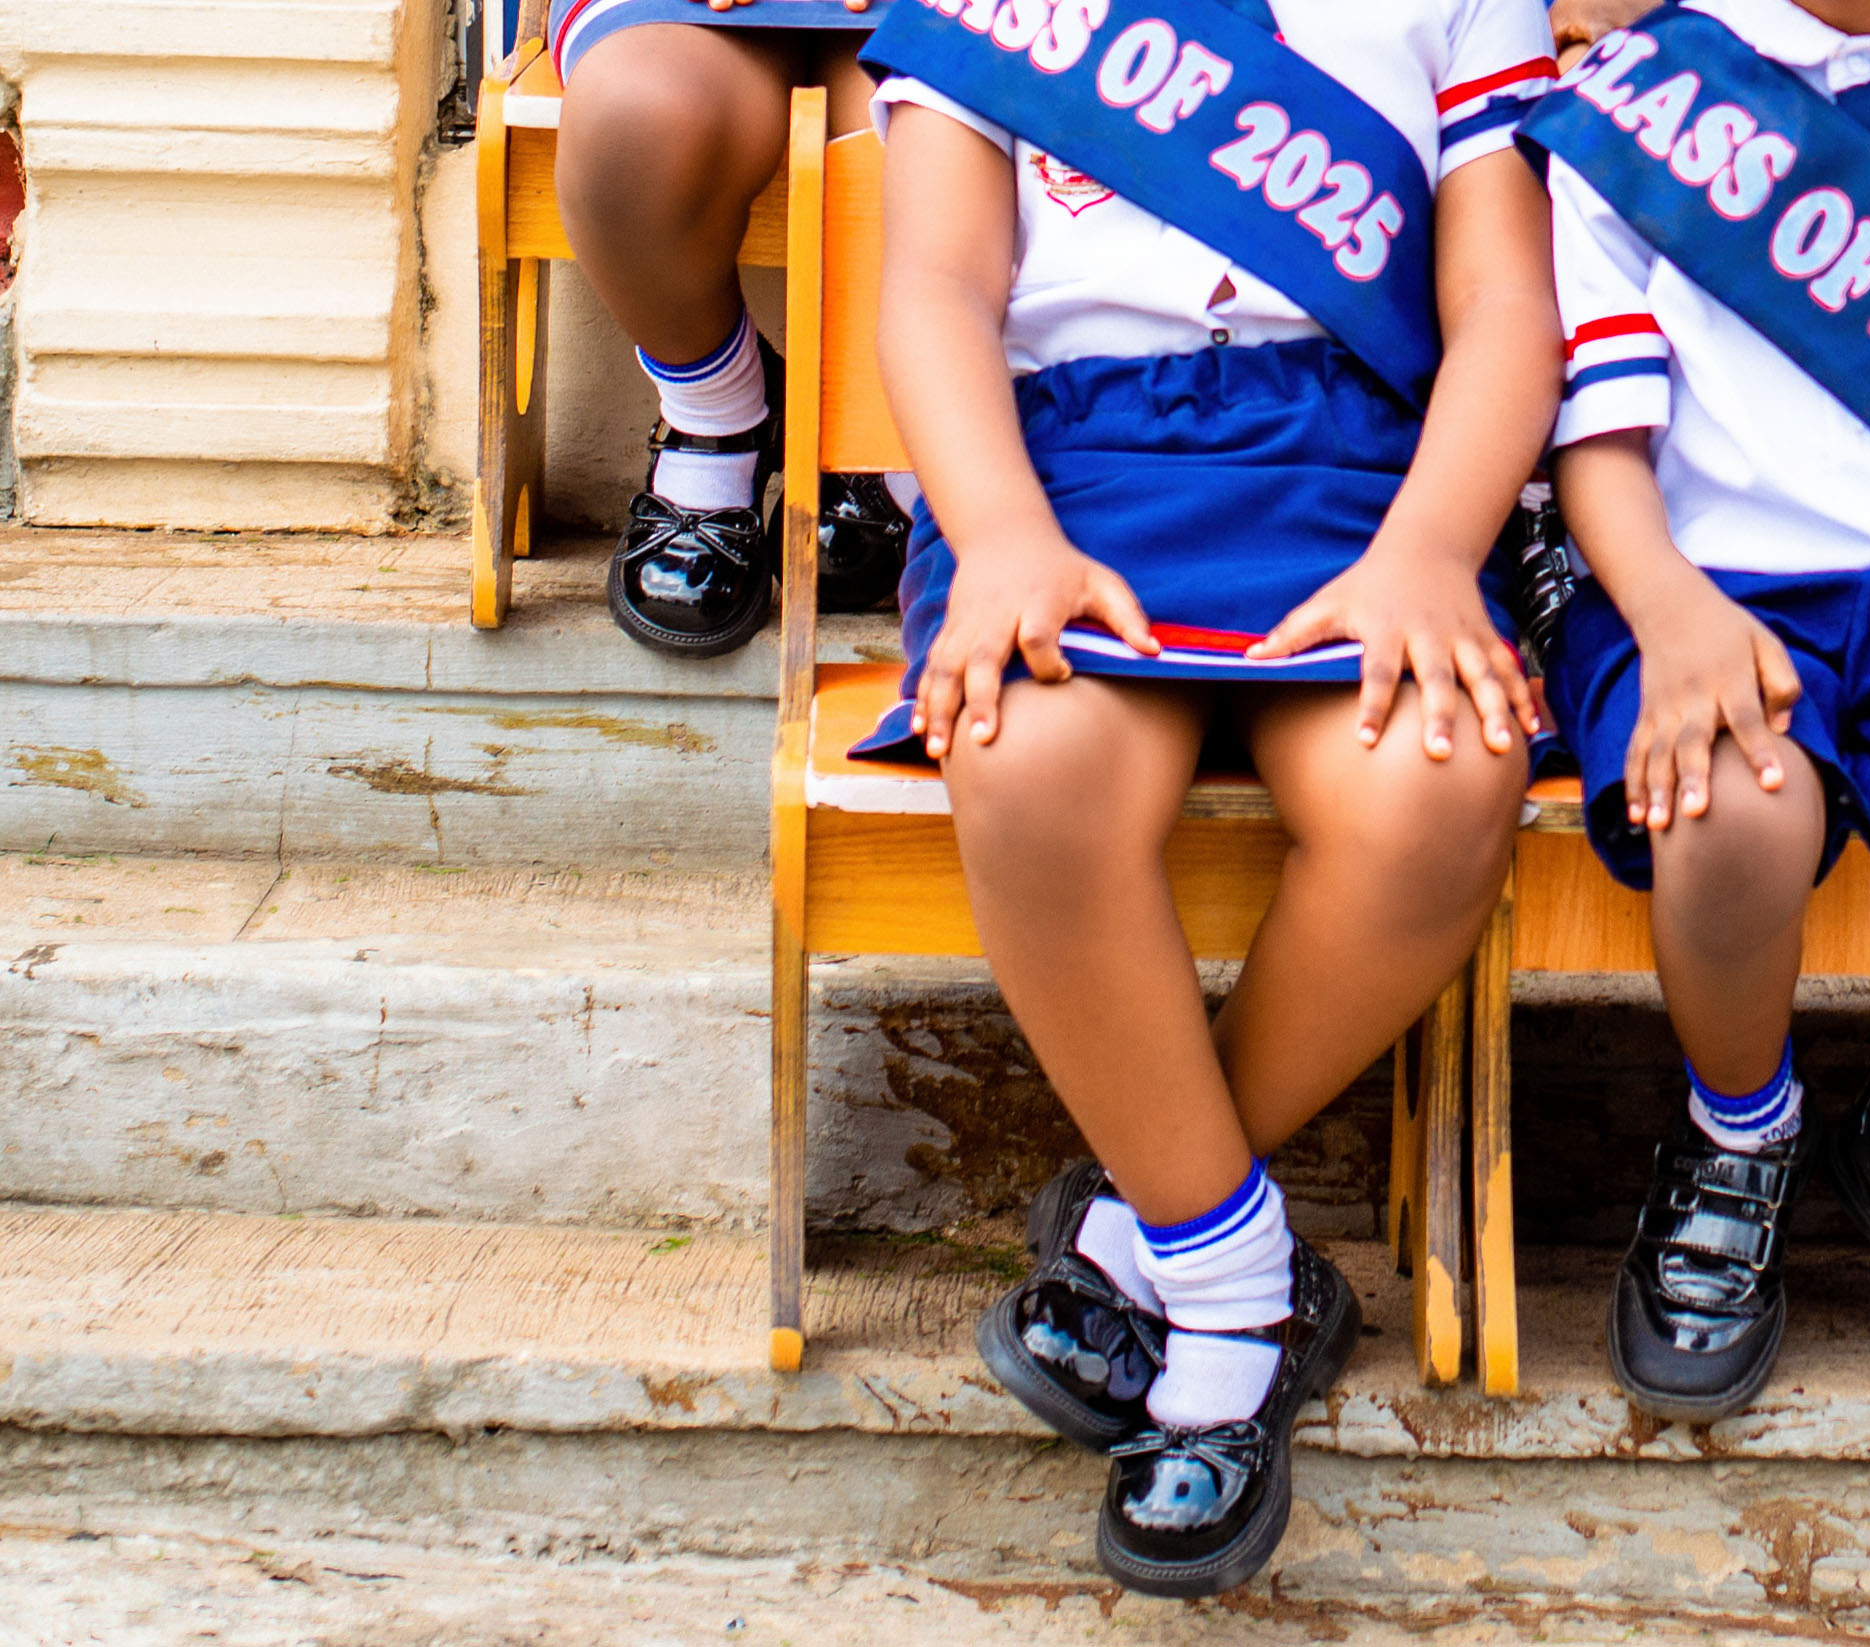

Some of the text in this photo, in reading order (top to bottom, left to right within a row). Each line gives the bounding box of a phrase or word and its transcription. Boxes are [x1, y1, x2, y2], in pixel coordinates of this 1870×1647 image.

[1096, 18, 1234, 134] OF
[1209, 101, 1405, 282] 2025
[1553, 28, 1797, 221] CLASS
